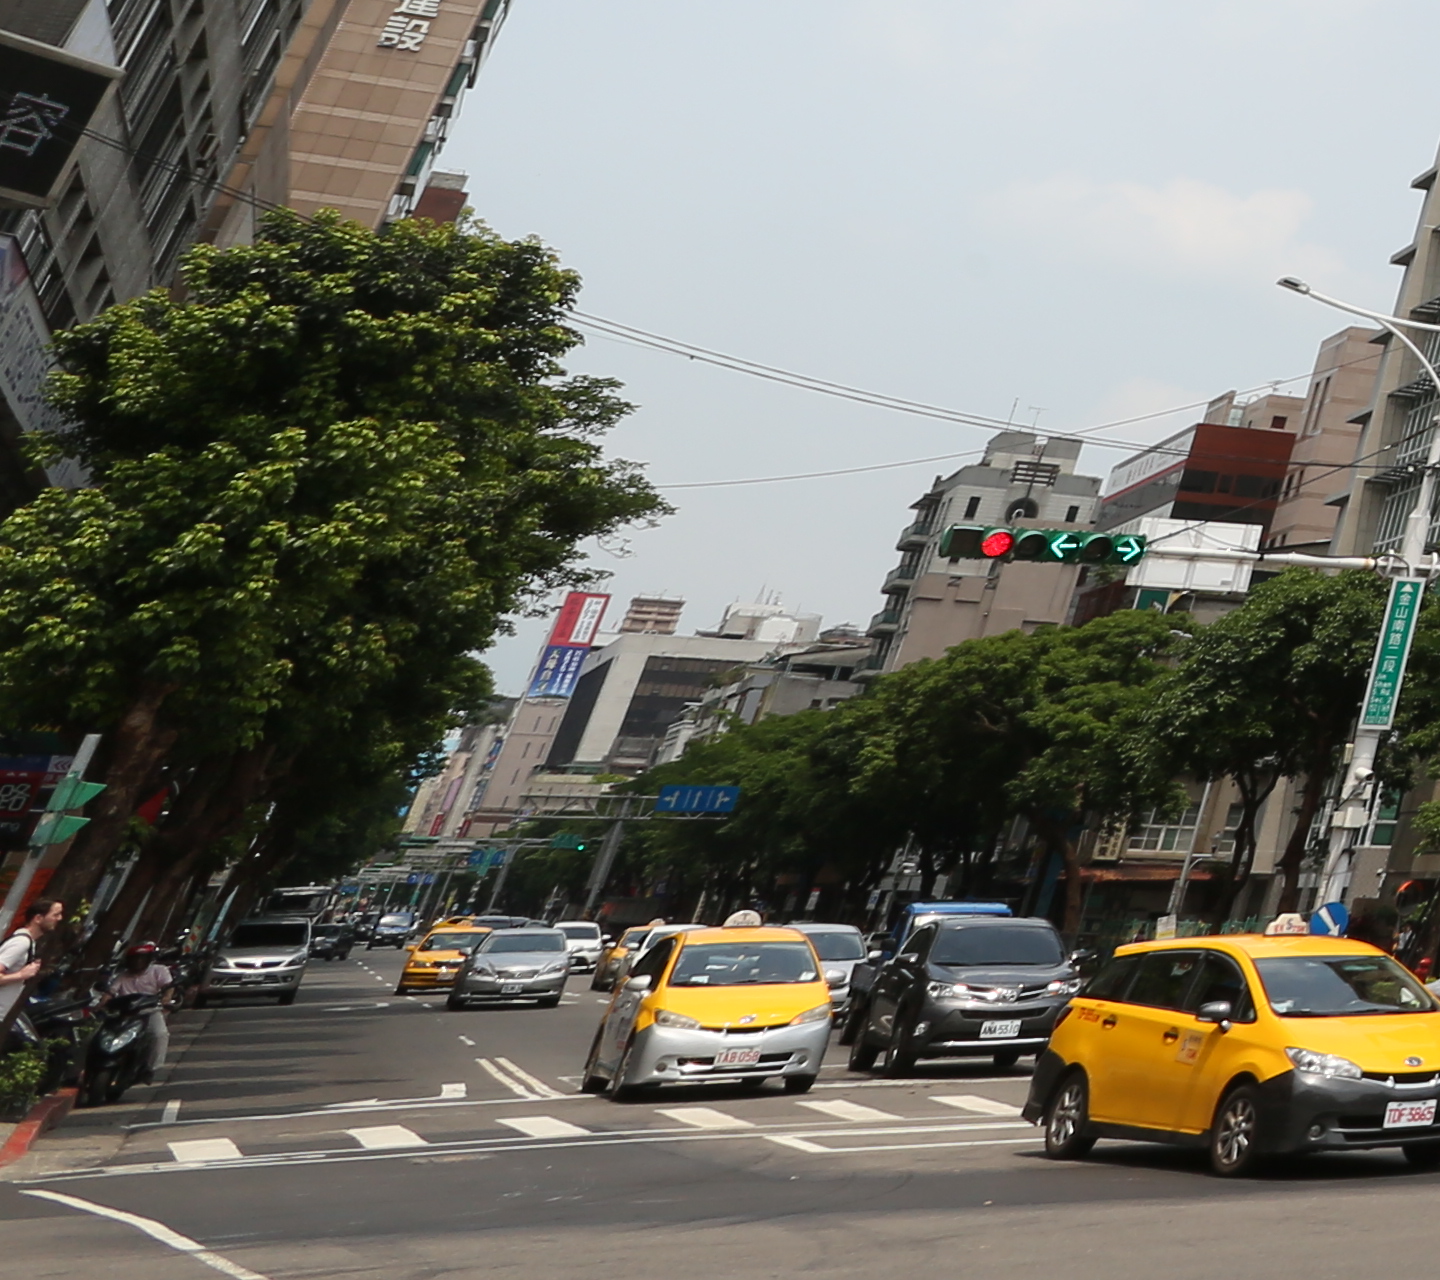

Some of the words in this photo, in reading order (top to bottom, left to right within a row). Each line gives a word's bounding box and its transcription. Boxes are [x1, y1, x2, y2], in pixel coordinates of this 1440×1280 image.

[1381, 593, 1412, 673] 金山南路二段
